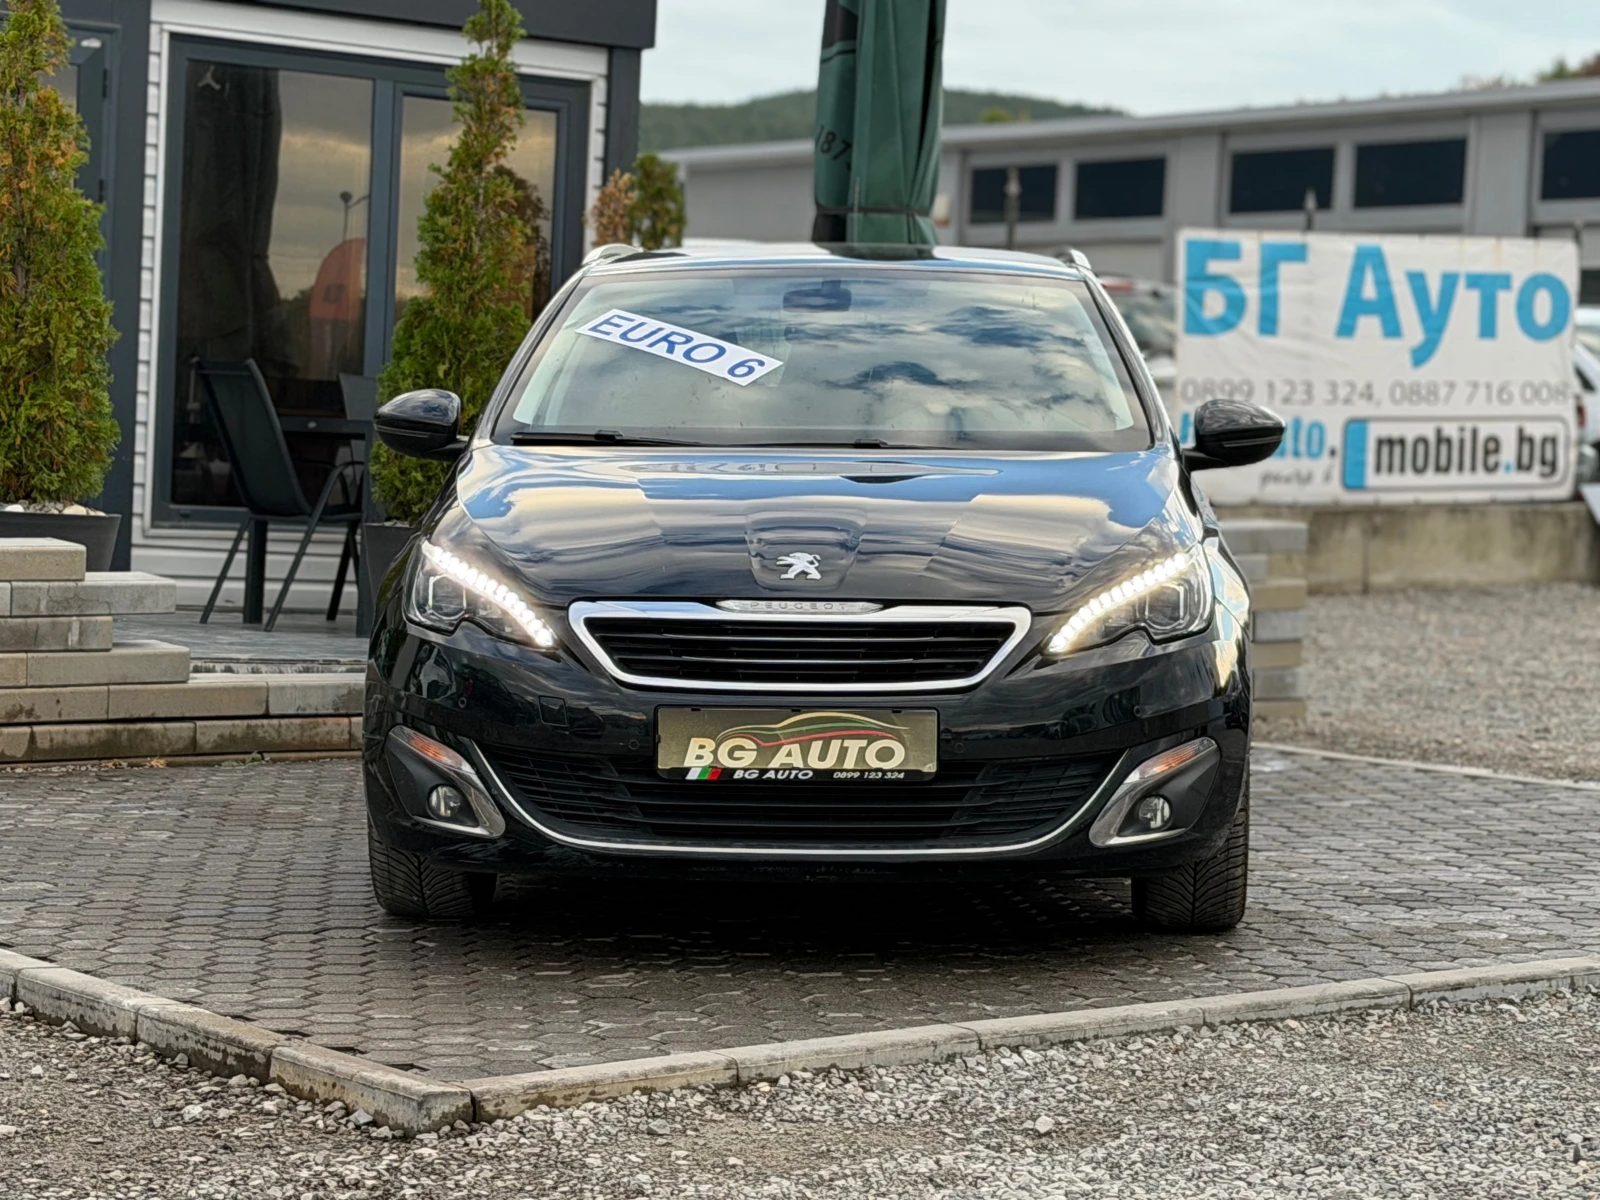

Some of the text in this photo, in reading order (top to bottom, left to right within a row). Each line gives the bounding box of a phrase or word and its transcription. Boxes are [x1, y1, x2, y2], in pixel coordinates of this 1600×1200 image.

[1185, 240, 1570, 368] БГ Ауто
[588, 314, 765, 378] EURO 6
[1181, 377, 1255, 405] 0899
[1265, 379, 1315, 405] 123
[1389, 381, 1457, 406] 0887
[1464, 381, 1515, 406] 716
[1519, 381, 1570, 406] 008
[1375, 425, 1558, 479] mobile.bg
[750, 602, 847, 610] PEUGEOT
[683, 738, 905, 769] BG AUTO
[733, 770, 905, 779] BG AUTO 0899 123 324
